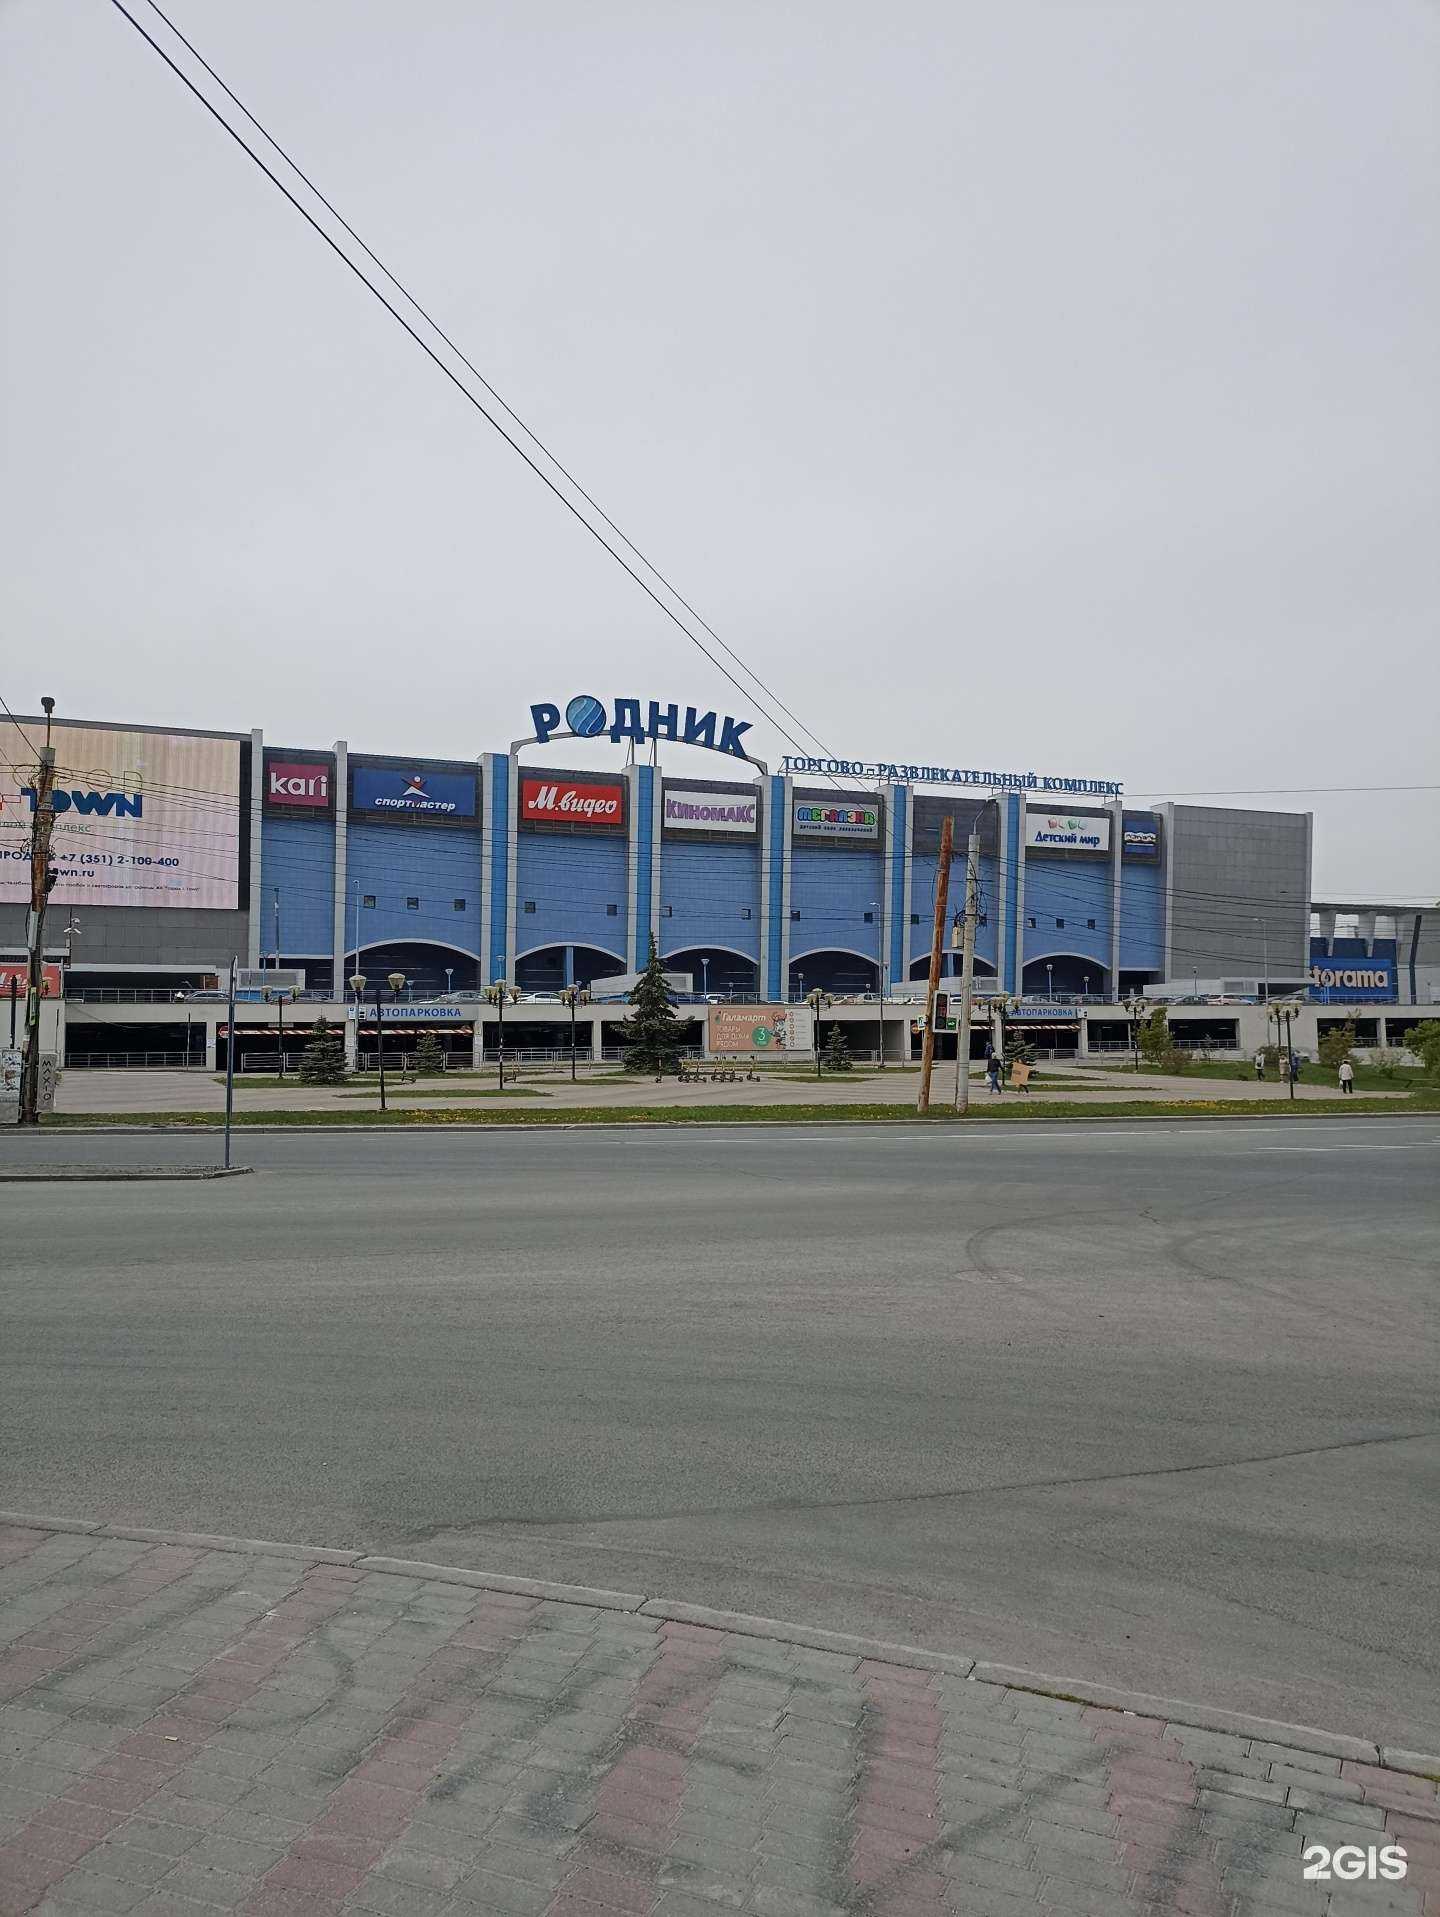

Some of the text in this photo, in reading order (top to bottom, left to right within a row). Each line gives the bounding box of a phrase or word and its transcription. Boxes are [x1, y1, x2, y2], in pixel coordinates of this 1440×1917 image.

[530, 695, 753, 759] РОДНИК
[270, 771, 327, 797] kari
[1043, 777, 1123, 794] КОМПЛЕКС
[21, 787, 143, 818] TOWN
[374, 798, 456, 812] спортмастер
[528, 785, 617, 818] М.видео
[666, 798, 755, 823] КИНОМАКС
[1035, 831, 1100, 847] Детский мир
[60, 853, 76, 862] +7
[81, 854, 113, 866] (351)
[1309, 965, 1389, 988] torama
[369, 1008, 462, 1017] АВТОПАРКОВКА
[722, 1012, 766, 1023] Галамарт
[758, 1027, 766, 1041] 3
